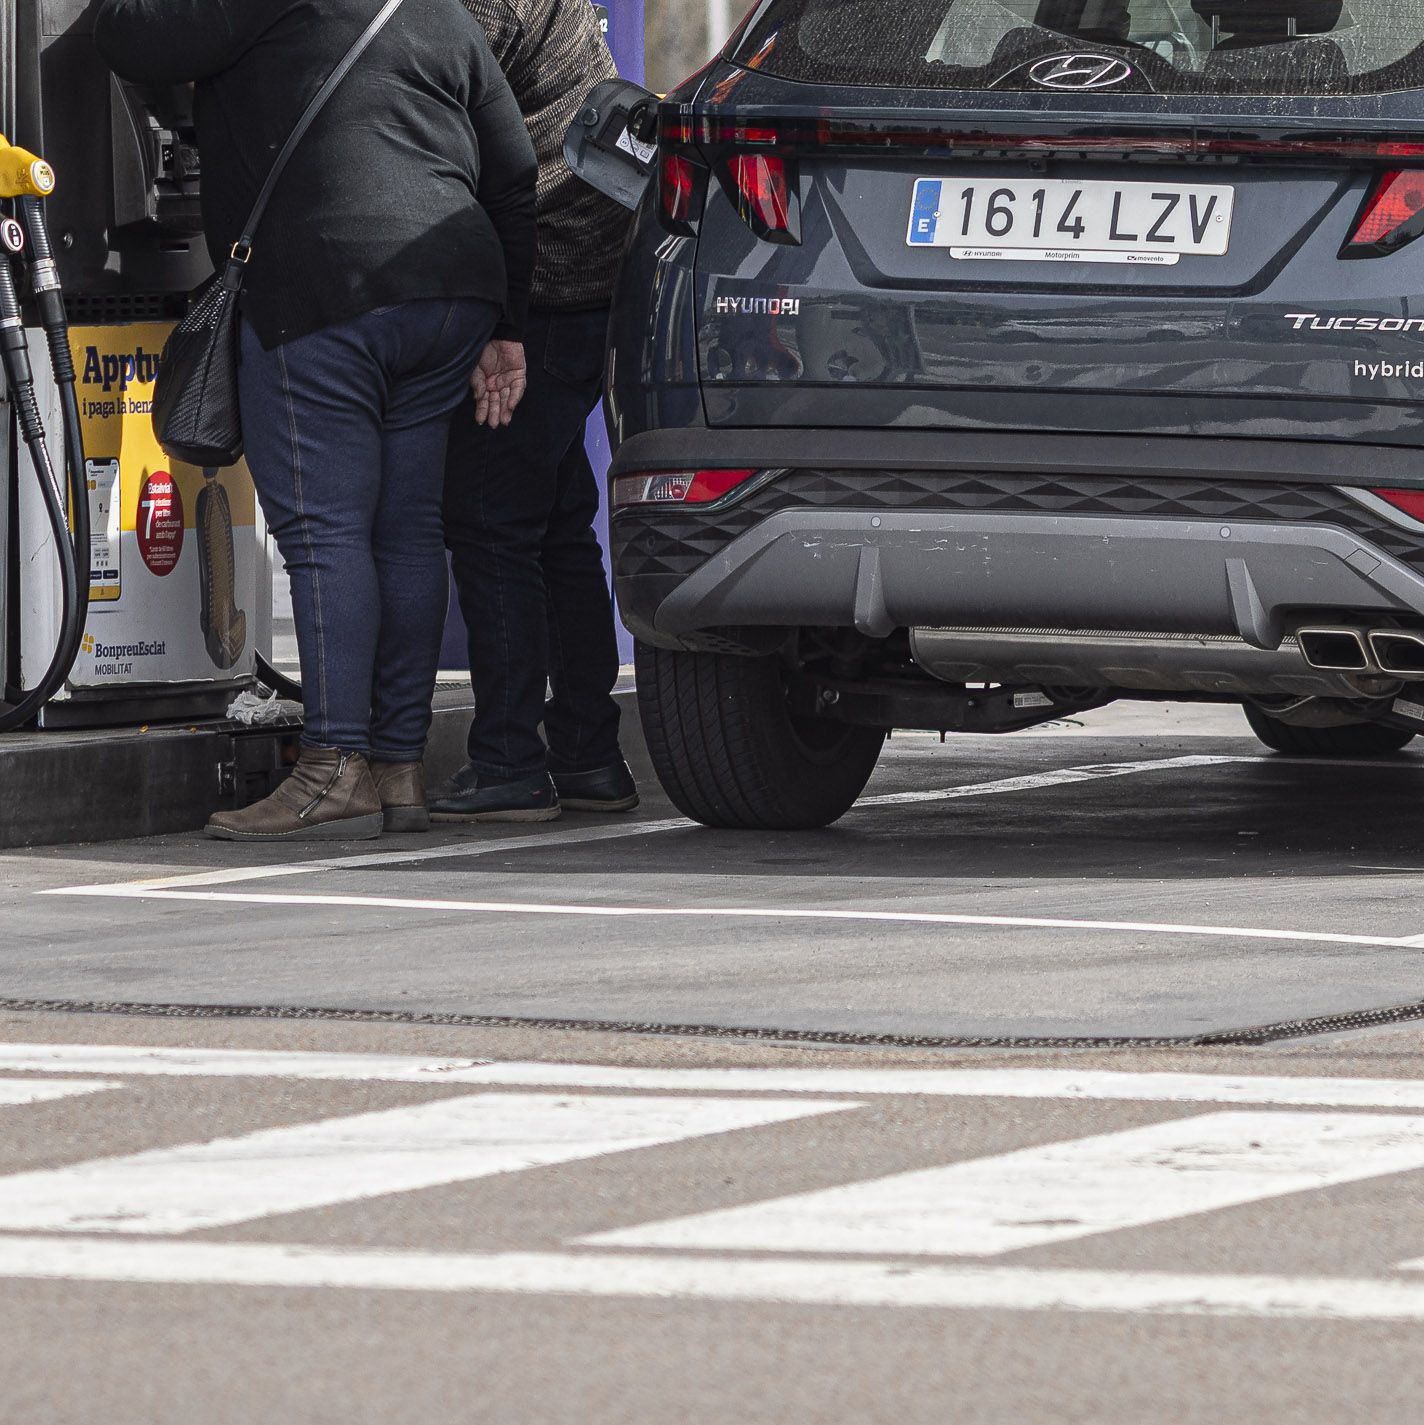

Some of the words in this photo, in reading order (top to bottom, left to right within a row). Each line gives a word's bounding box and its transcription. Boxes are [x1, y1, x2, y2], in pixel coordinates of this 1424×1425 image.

[917, 219, 930, 232] E
[961, 187, 1085, 239] 1614
[1108, 191, 1218, 244] LZV
[1044, 251, 1080, 260] Motorprim
[716, 296, 800, 315] HYUNDAI
[82, 346, 161, 392] Apptu
[1354, 360, 1424, 380] hybrid
[82, 398, 87, 415] i
[88, 401, 116, 419] paga
[117, 397, 127, 414] la
[128, 397, 153, 414] benz
[141, 500, 156, 539] 7
[95, 640, 166, 660] BonpreuEsclat
[95, 662, 133, 676] MOBILITAT
